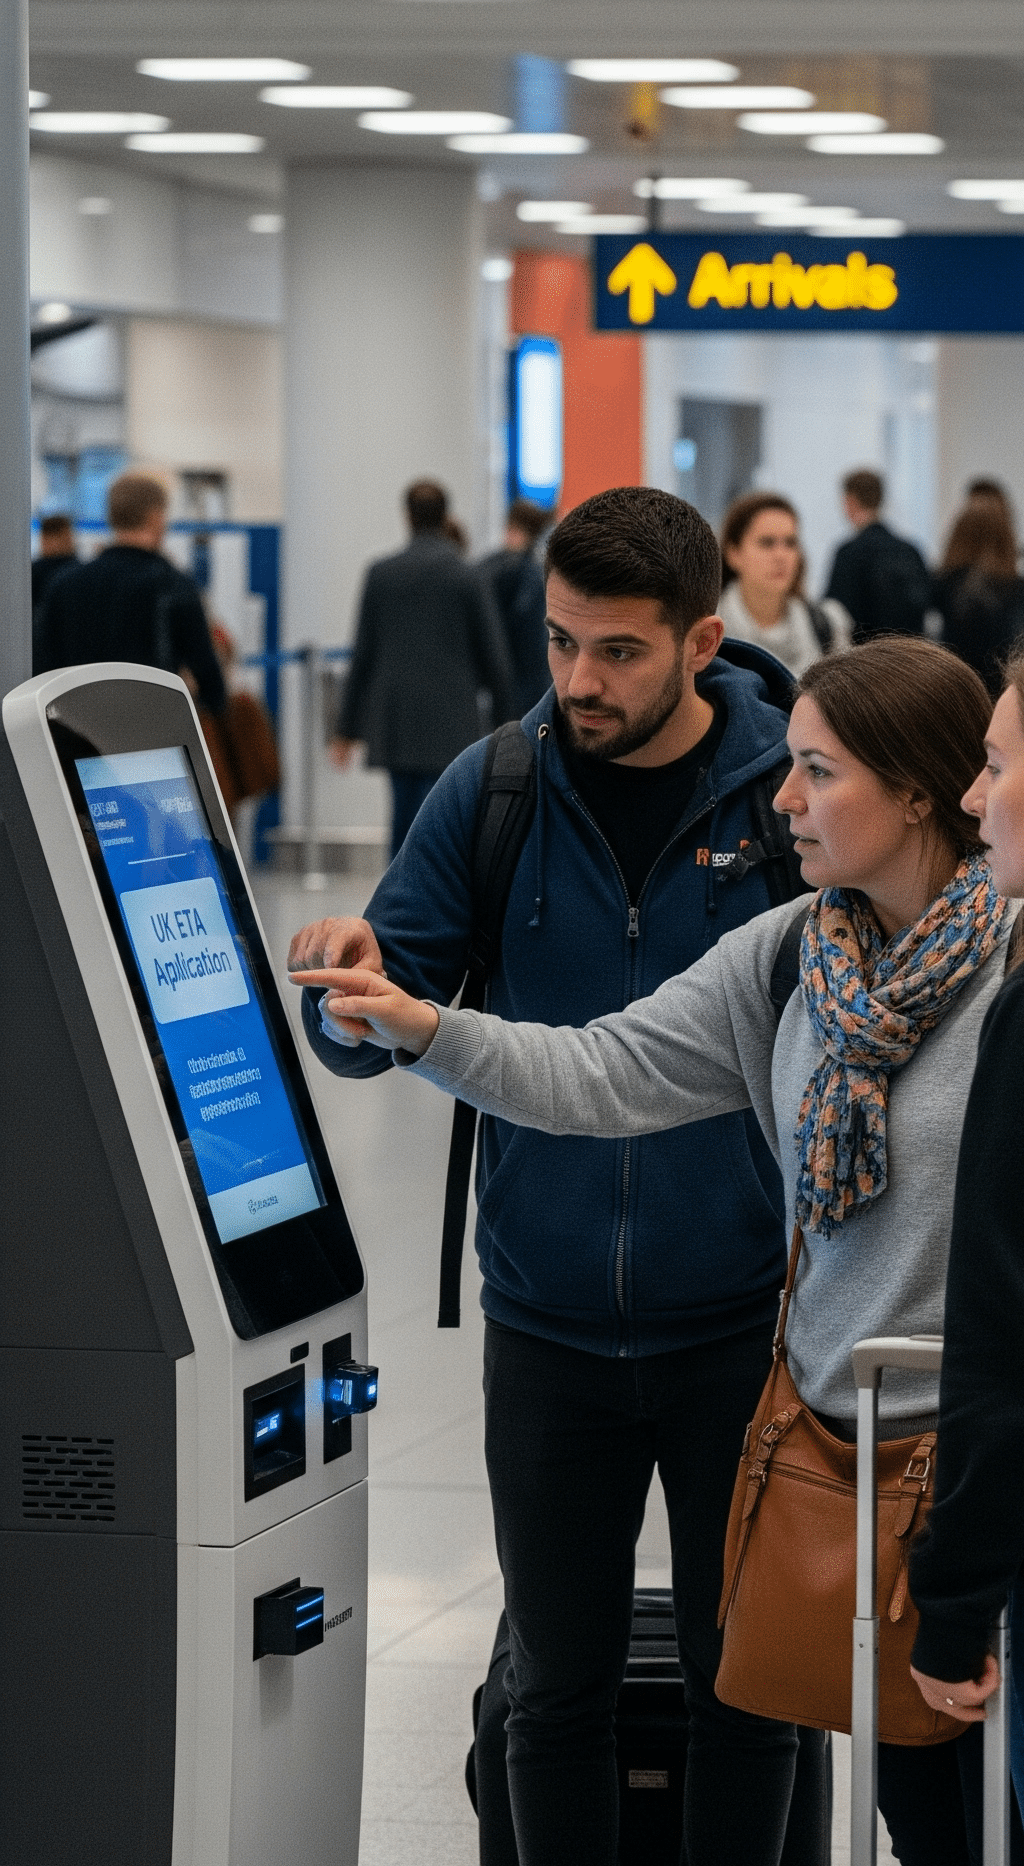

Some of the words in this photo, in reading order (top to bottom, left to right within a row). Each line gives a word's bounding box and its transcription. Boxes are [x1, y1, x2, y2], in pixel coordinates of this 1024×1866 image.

[687, 251, 898, 310] Arrivals
[150, 911, 177, 943] UK
[174, 908, 207, 938] ETA
[154, 947, 232, 992] Application
